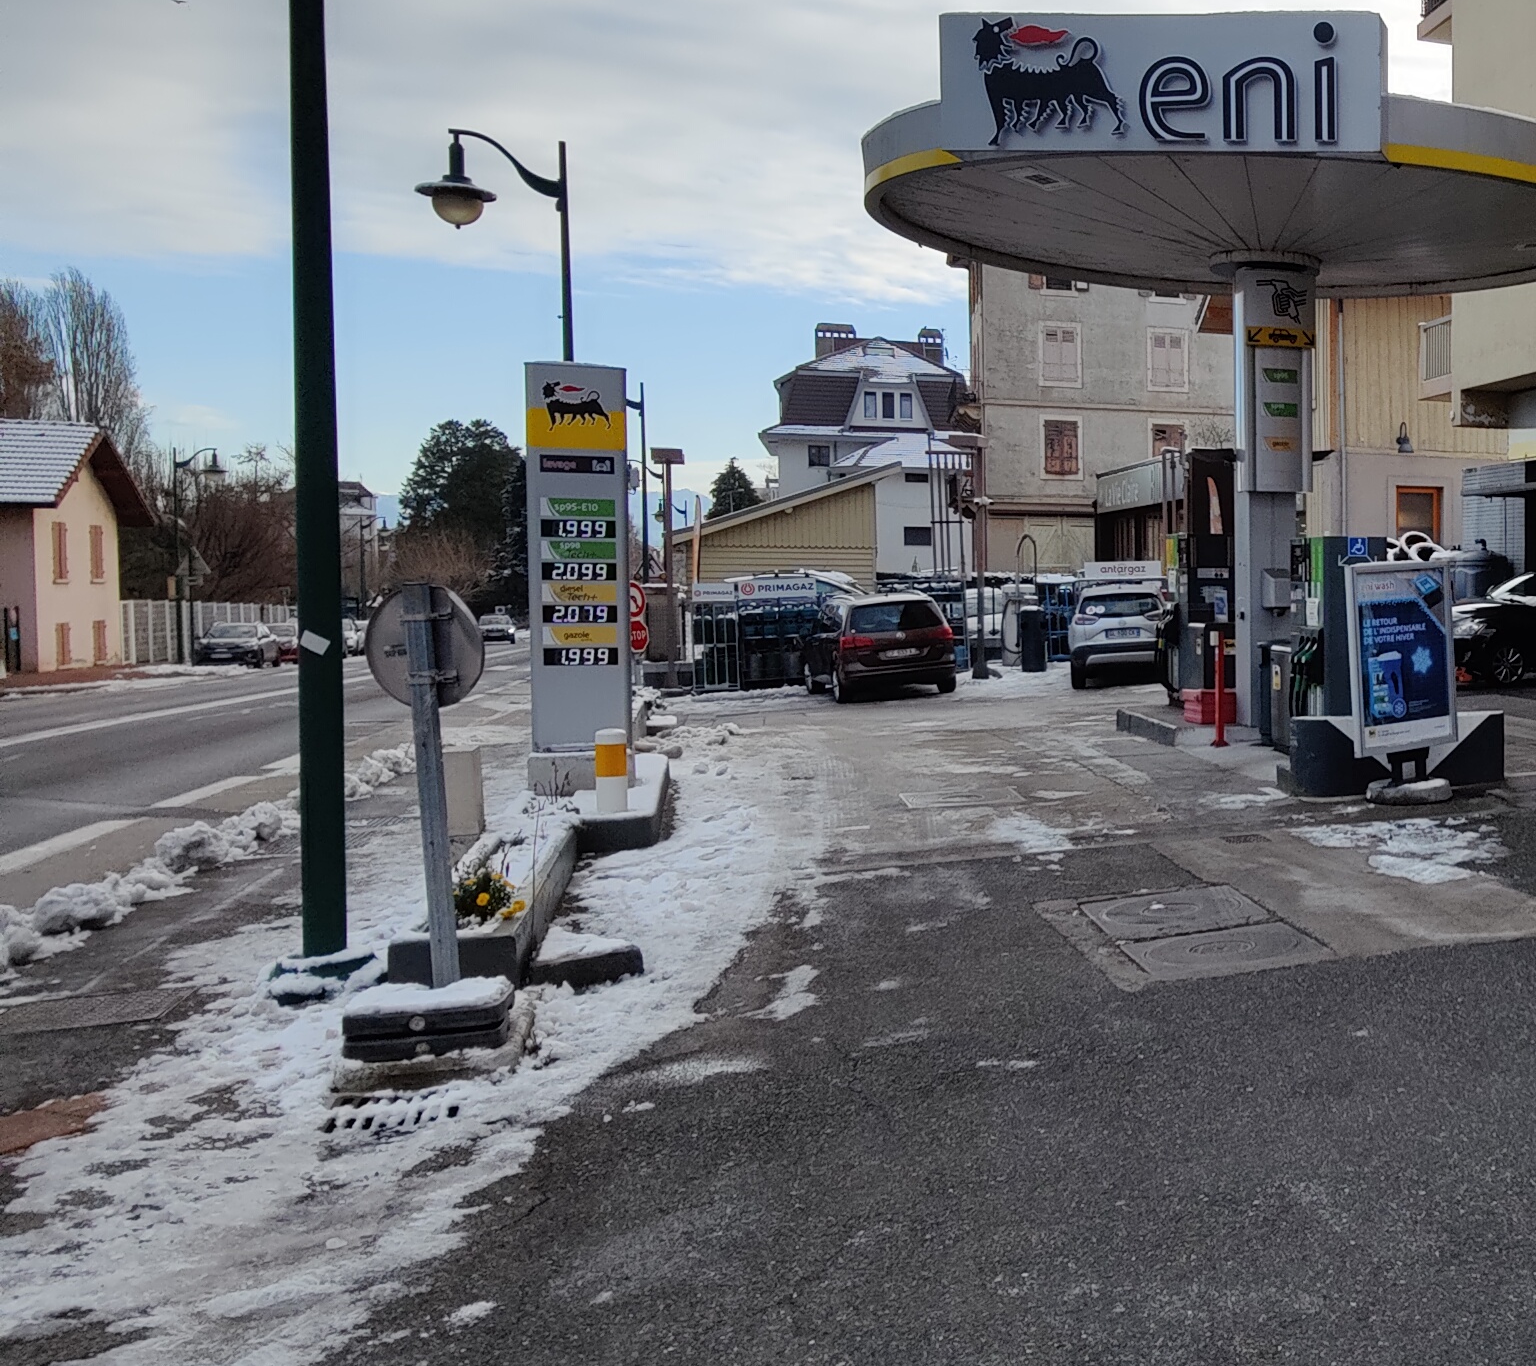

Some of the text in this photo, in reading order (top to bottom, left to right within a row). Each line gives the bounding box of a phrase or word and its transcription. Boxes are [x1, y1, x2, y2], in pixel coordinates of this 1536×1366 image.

[1138, 21, 1337, 142] eni
[554, 502, 598, 513] sp95-E10
[558, 520, 606, 538] 1.999
[559, 541, 581, 550] sp98
[552, 563, 607, 580] 2.099
[1100, 565, 1146, 575] antargaz
[560, 585, 583, 593] diesel
[757, 582, 815, 593] PRIMAGAZ
[567, 592, 598, 602] Tech+
[552, 606, 608, 623] 2.079
[1372, 617, 1398, 626] RETOUR
[563, 631, 590, 641] gazole
[561, 648, 609, 666] 1.999
